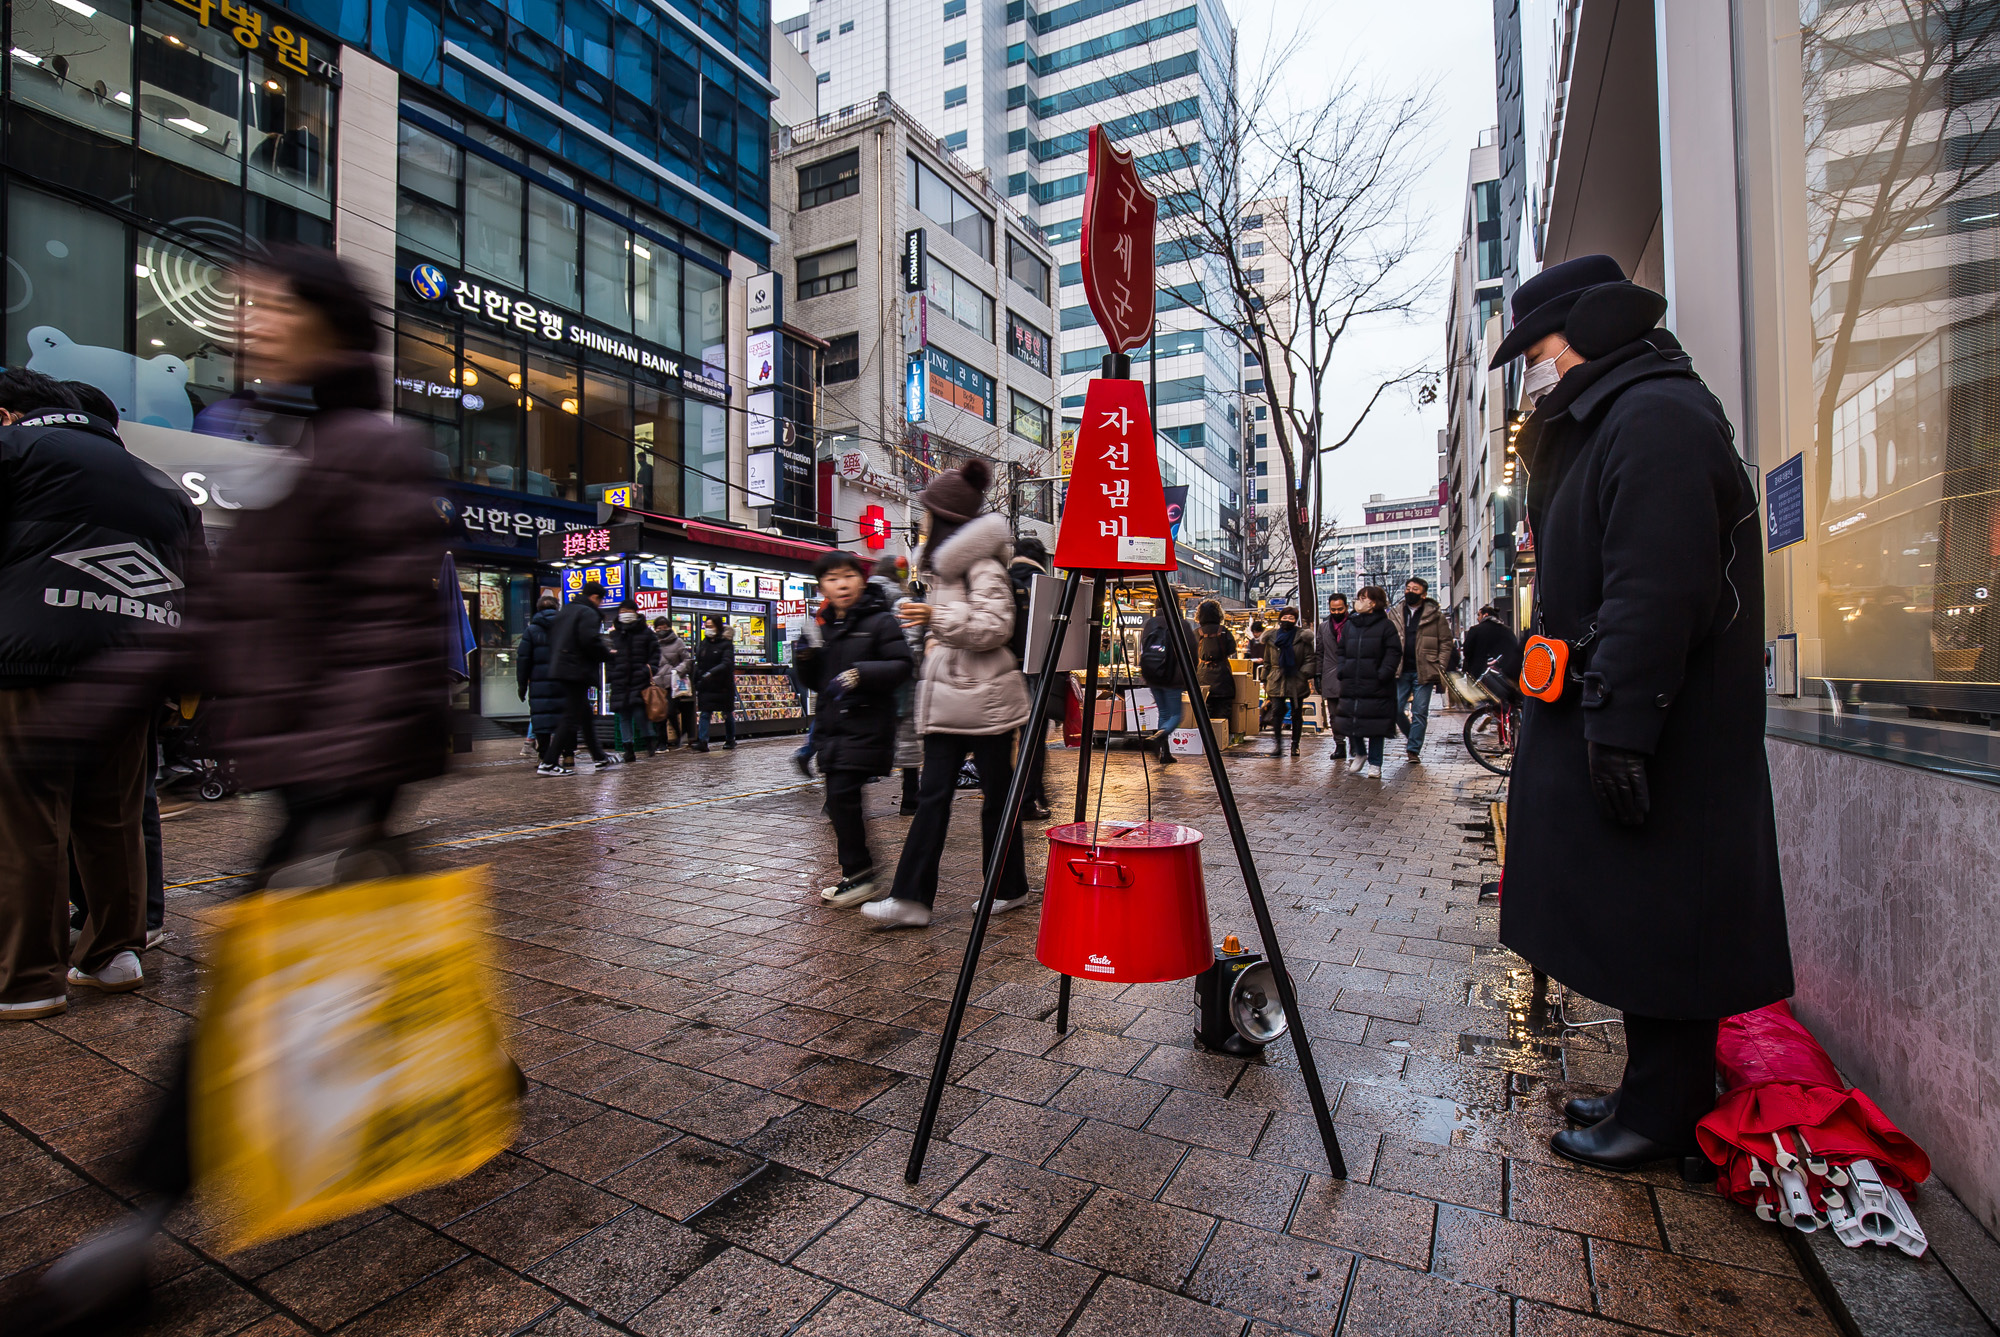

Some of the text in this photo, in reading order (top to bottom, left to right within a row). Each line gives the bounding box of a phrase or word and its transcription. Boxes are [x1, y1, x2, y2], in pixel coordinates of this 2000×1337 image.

[309, 53, 340, 79] 7F
[909, 232, 918, 286] TONYMOLY
[1113, 173, 1138, 330] 구세군
[453, 279, 563, 341] 신한은행
[749, 304, 772, 315] Shinhan
[569, 325, 680, 378] SHINHAN BANK
[1015, 324, 1041, 357] 부동산
[925, 349, 949, 373] LINE
[912, 363, 921, 410] LINE
[21, 413, 89, 428] BRO
[750, 467, 756, 478] 2
[842, 452, 861, 476] 藥
[1098, 406, 1135, 537] 자선냄비
[461, 504, 556, 538] 신한은행
[563, 529, 611, 557] 換錢
[567, 565, 622, 589] 상품권
[44, 588, 182, 629] UMBRO
[636, 592, 658, 609] SIM
[777, 601, 796, 614] SIM
